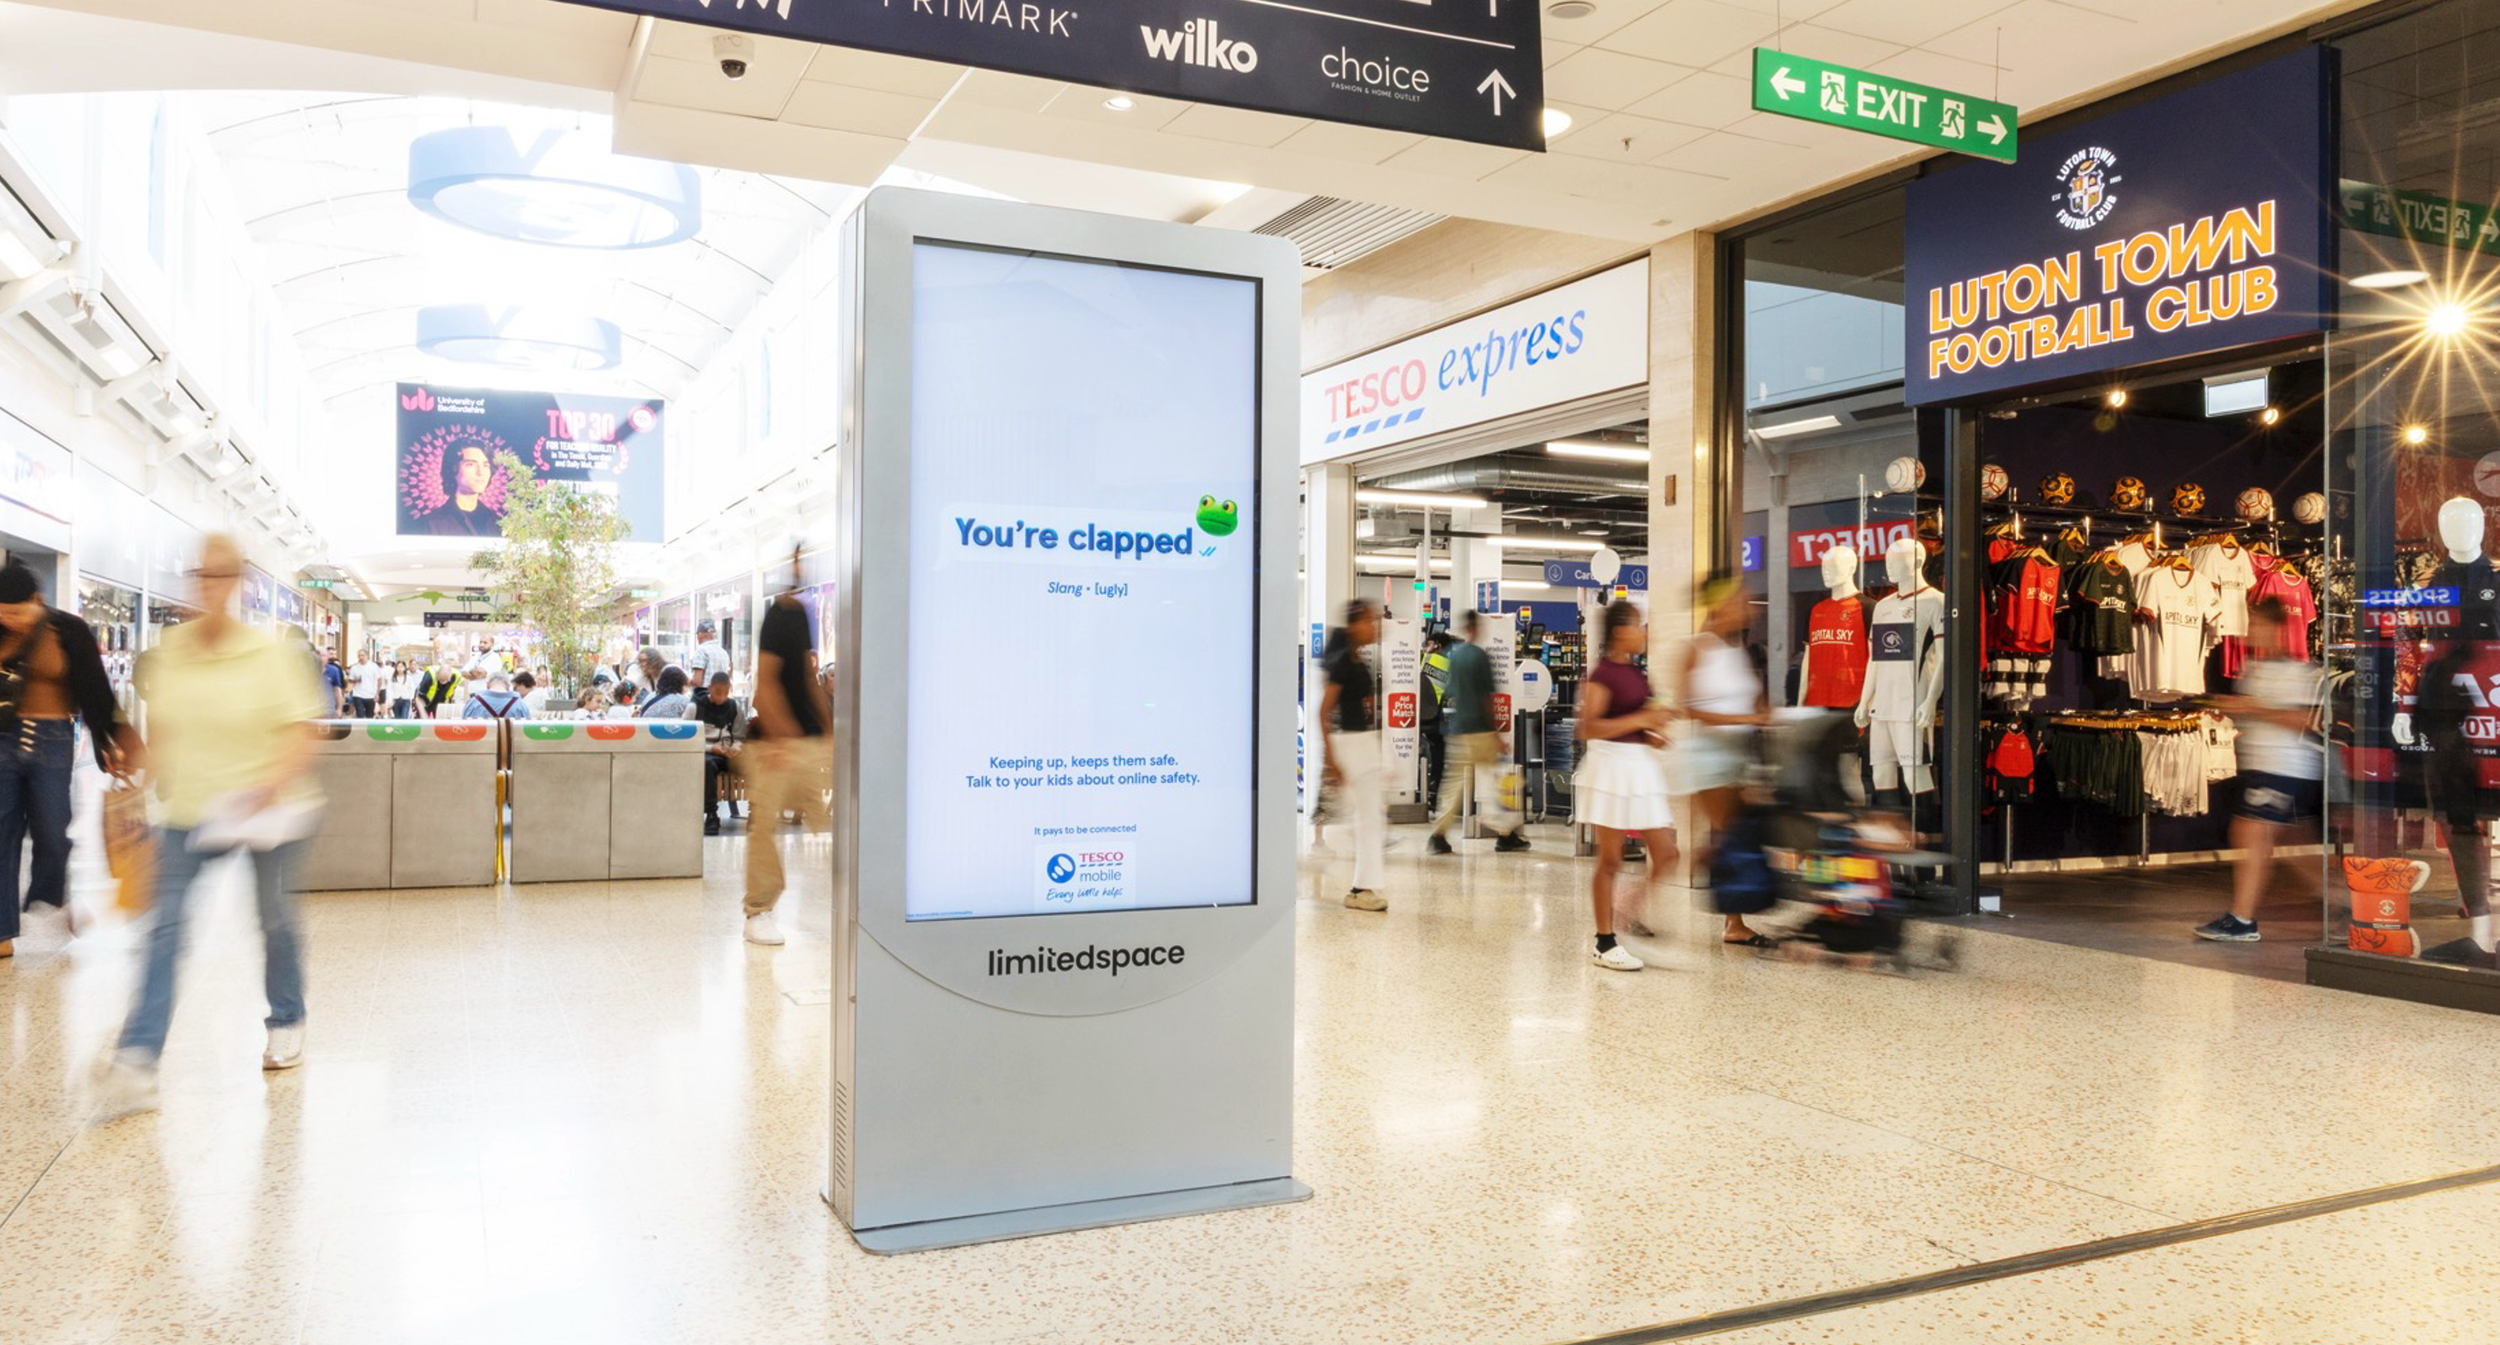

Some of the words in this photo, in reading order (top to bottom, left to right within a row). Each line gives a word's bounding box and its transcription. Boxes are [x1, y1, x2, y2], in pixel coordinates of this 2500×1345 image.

[883, 0, 1070, 37] IMARK
[1140, 18, 1258, 73] wilko
[1321, 46, 1430, 92] choice
[1331, 82, 1362, 93] FASHION
[1371, 89, 1392, 98] HOME
[1394, 92, 1420, 102] OUTLET
[1856, 81, 1927, 128] EXIT
[2056, 149, 2087, 182] LUTON
[2088, 146, 2117, 168] TOWN
[2056, 208, 2097, 231] FOOTBALL
[2095, 195, 2117, 221] CLUB
[1929, 251, 2081, 335] LUTON
[2095, 199, 2275, 295] TOWN
[1929, 298, 2134, 379] FOOTBALL
[2146, 265, 2278, 333] CLUB
[1324, 359, 1427, 423] TESCO
[1438, 309, 1586, 398] express
[437, 396, 475, 407] University
[476, 398, 485, 406] of
[546, 409, 586, 441] TOP
[588, 412, 615, 442] 30
[546, 441, 559, 450] FOR
[1068, 523, 1193, 561] clapped
[1047, 581, 1083, 597] Slang
[1095, 582, 1129, 598] [ugly]
[1836, 628, 1854, 641] SKY
[1392, 709, 1414, 718] Match
[1395, 702, 1413, 710] Price
[990, 757, 1043, 771] Keeping
[1046, 758, 1068, 770] up,
[1071, 756, 1109, 769] keeps
[1112, 755, 1147, 767] them
[1150, 754, 1179, 766] safe.
[966, 775, 992, 788] Talk
[995, 776, 1010, 787] to
[1013, 777, 1043, 790] your
[1047, 774, 1073, 786] kids
[1076, 773, 1114, 786] about
[1118, 772, 1157, 785] online
[1160, 772, 1200, 786] safety.
[1034, 827, 1041, 835] It
[1042, 827, 1063, 837] pays
[1065, 826, 1075, 834] to
[1076, 825, 1088, 834] be
[1089, 824, 1137, 834] connected
[1079, 851, 1124, 862] TESCO
[1080, 869, 1122, 882] mobile
[1046, 887, 1074, 903] Every
[1077, 887, 1099, 898] little
[1102, 887, 1124, 899] helps
[988, 944, 1185, 977] limitedspace
